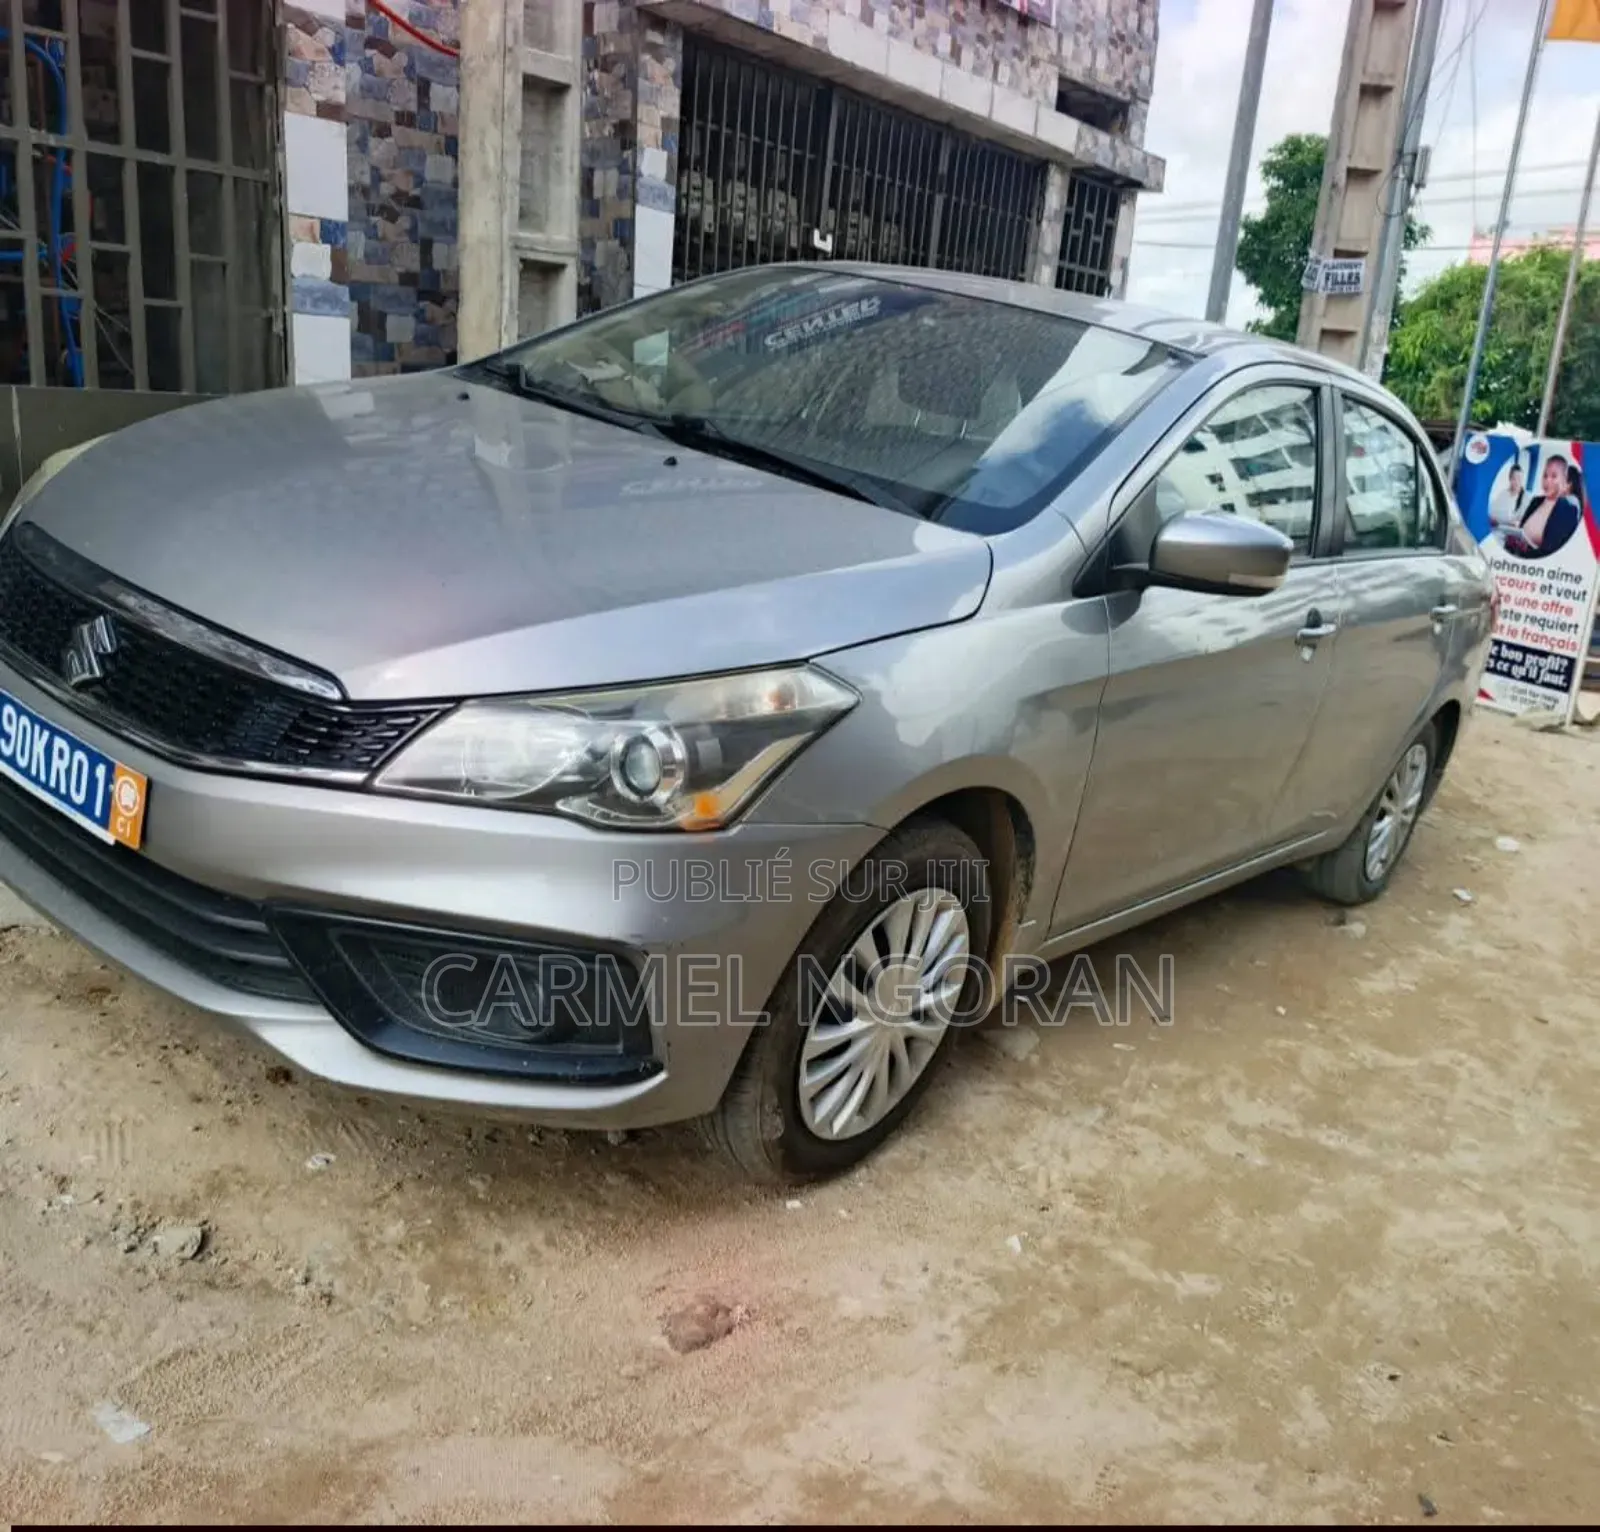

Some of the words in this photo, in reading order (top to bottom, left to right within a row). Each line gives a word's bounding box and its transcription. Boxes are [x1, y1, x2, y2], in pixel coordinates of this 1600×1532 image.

[1324, 271, 1361, 286] FILLES
[1547, 567, 1583, 585] aime
[1540, 583, 1554, 595] et
[1556, 589, 1588, 602] veut
[1514, 596, 1539, 609] une
[1541, 600, 1574, 618] offre
[1507, 625, 1519, 639] le
[1524, 611, 1579, 635] requiert
[1496, 660, 1511, 672] ce
[1501, 643, 1524, 662] bon
[1525, 653, 1569, 673] profil?
